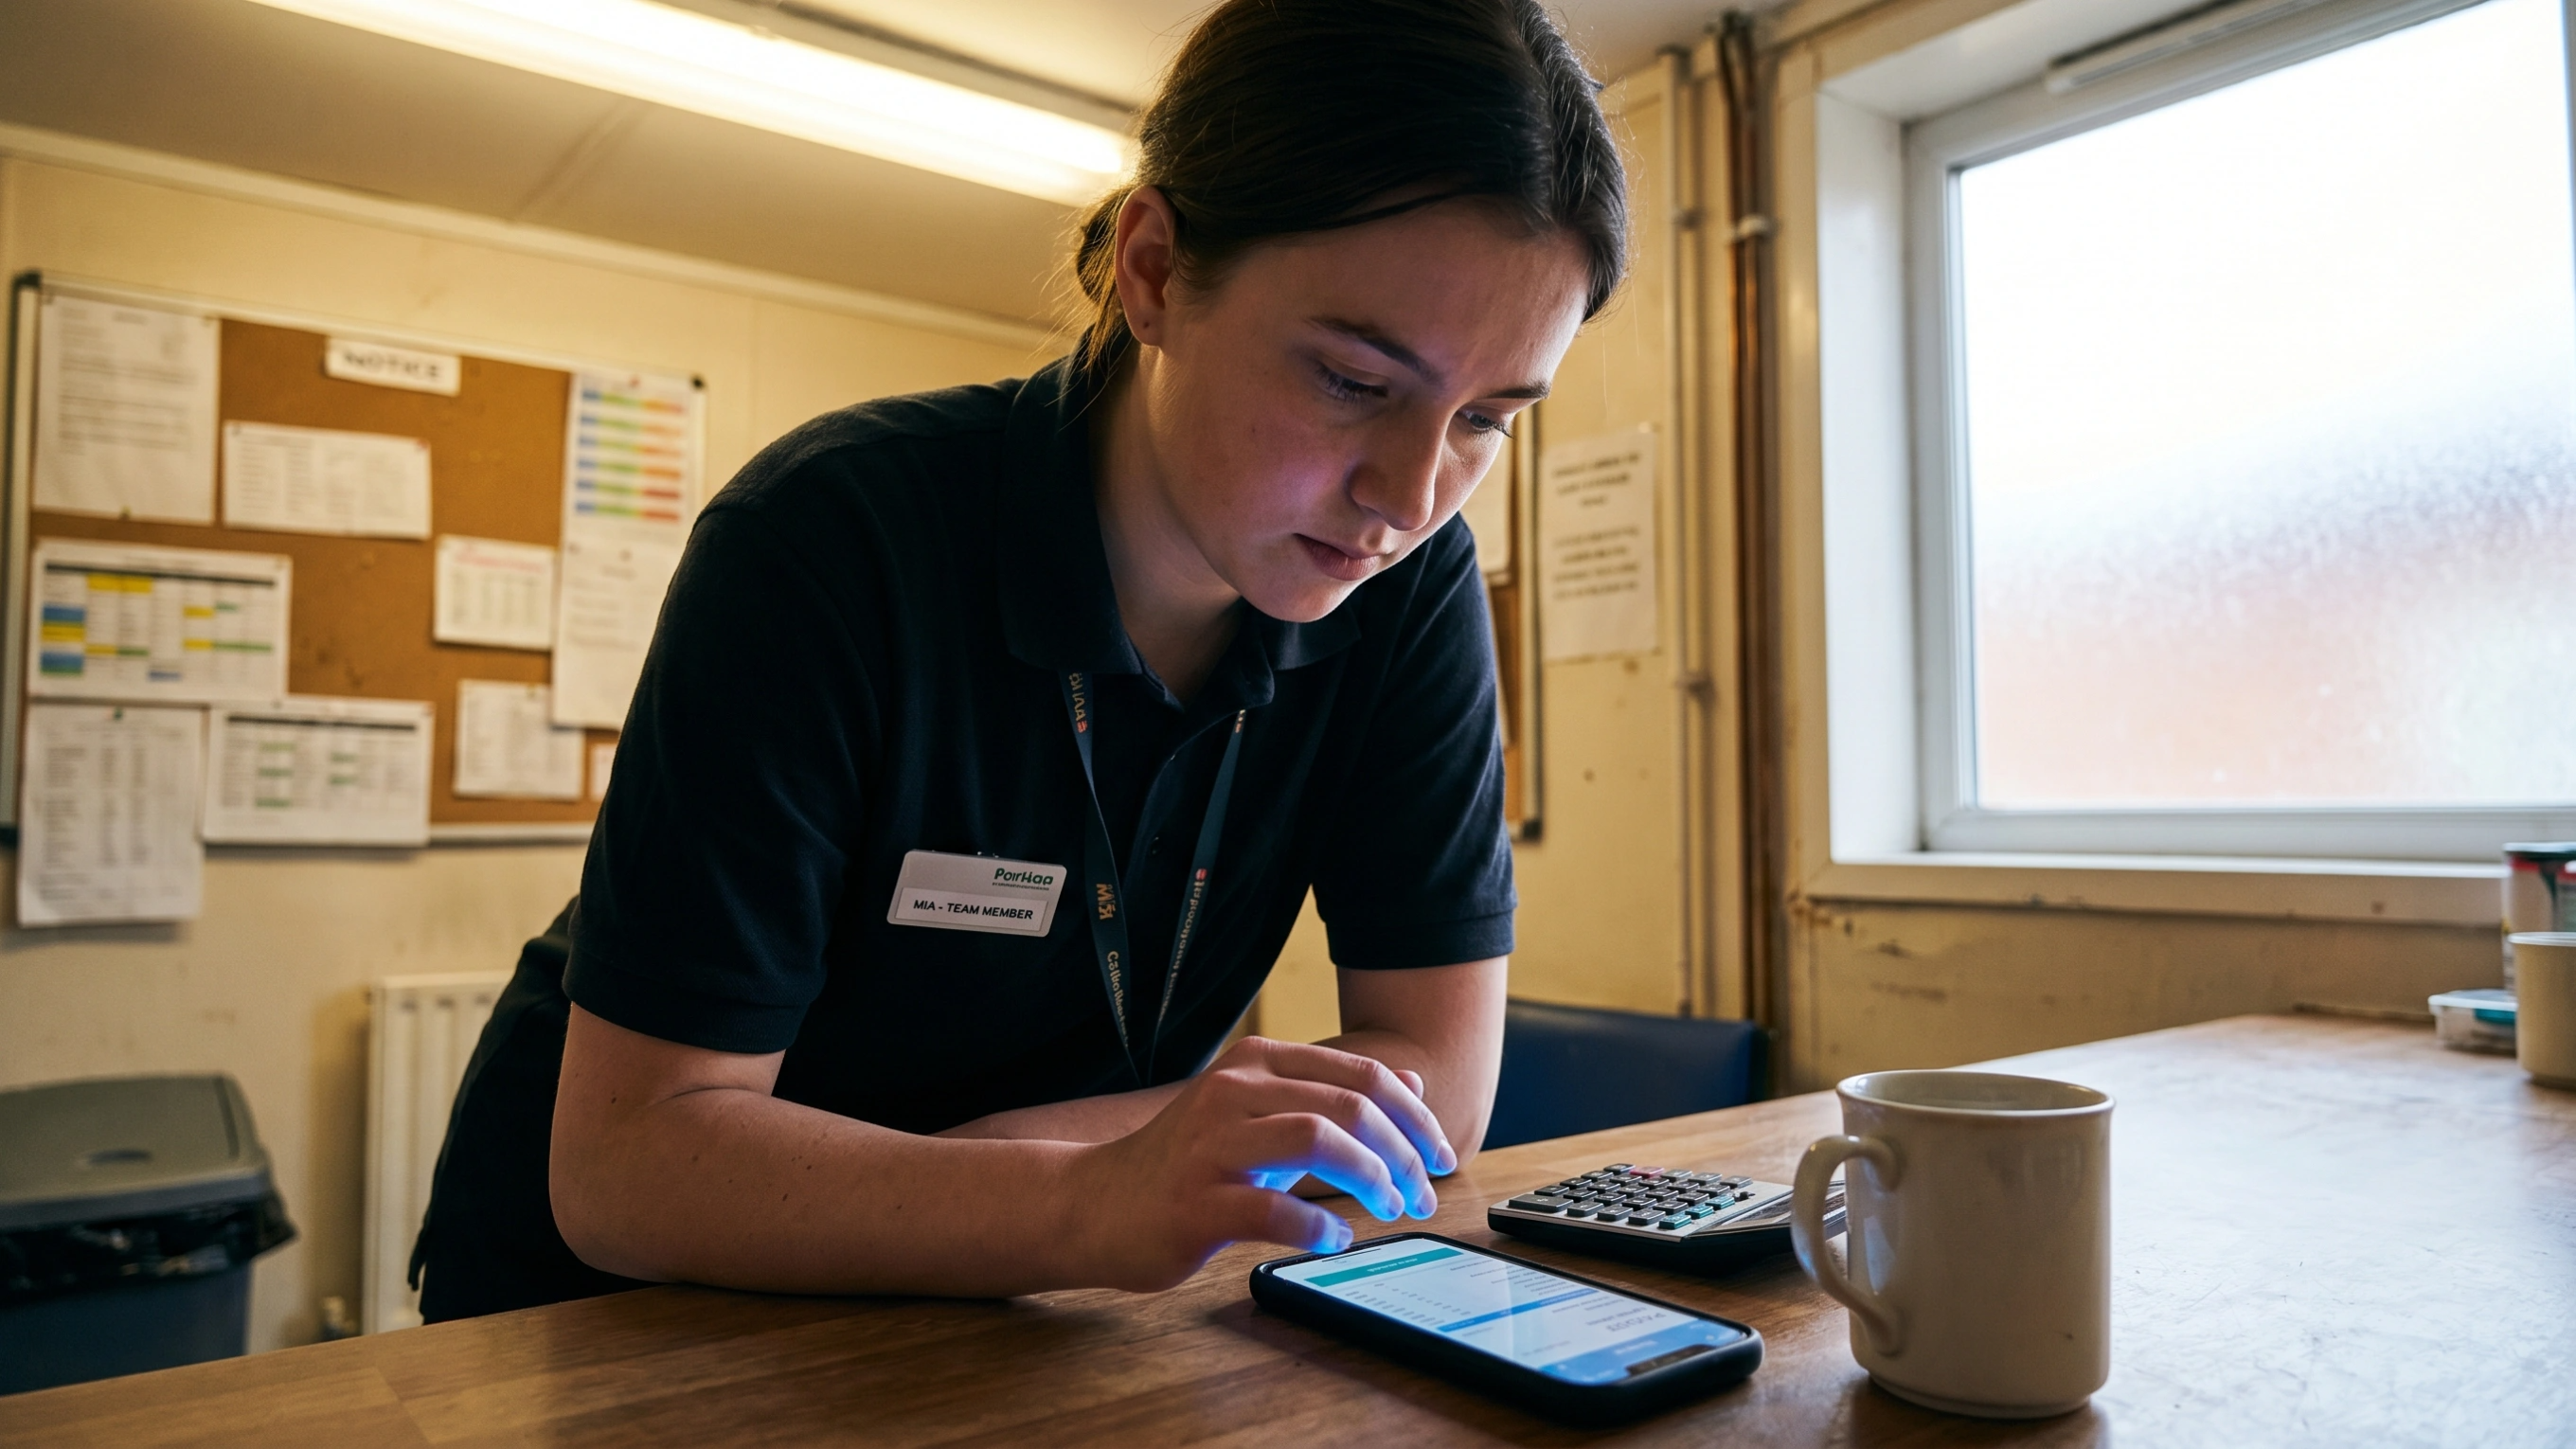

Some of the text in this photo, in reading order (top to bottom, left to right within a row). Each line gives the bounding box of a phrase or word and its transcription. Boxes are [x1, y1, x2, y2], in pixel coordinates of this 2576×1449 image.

[342, 349, 442, 381] NOTICE
[913, 899, 936, 911] MIA
[947, 903, 980, 915] TEAM
[981, 906, 1033, 920] MEMBER
